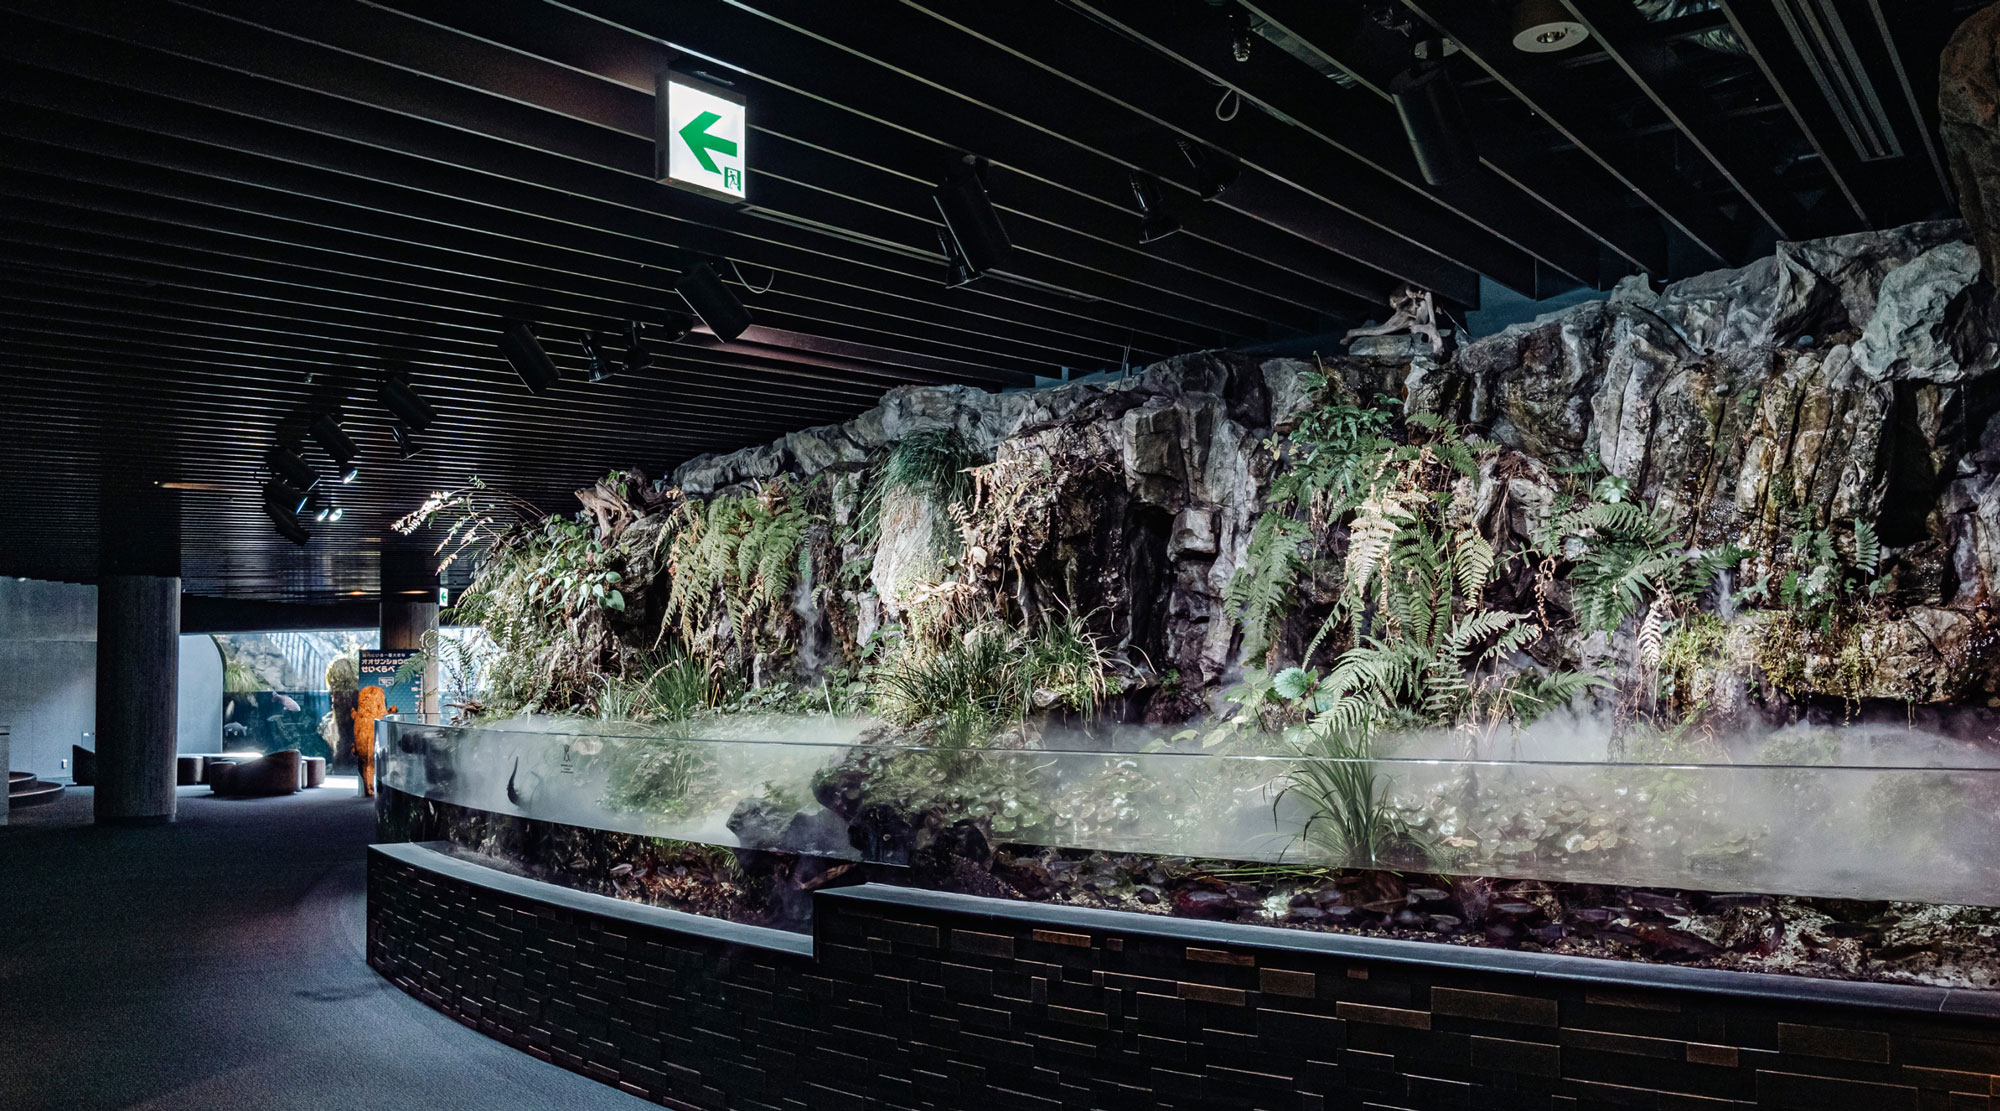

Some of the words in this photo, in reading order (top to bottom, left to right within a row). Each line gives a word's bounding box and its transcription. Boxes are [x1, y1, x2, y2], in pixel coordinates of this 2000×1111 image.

[361, 665, 396, 673] せいくらべ
